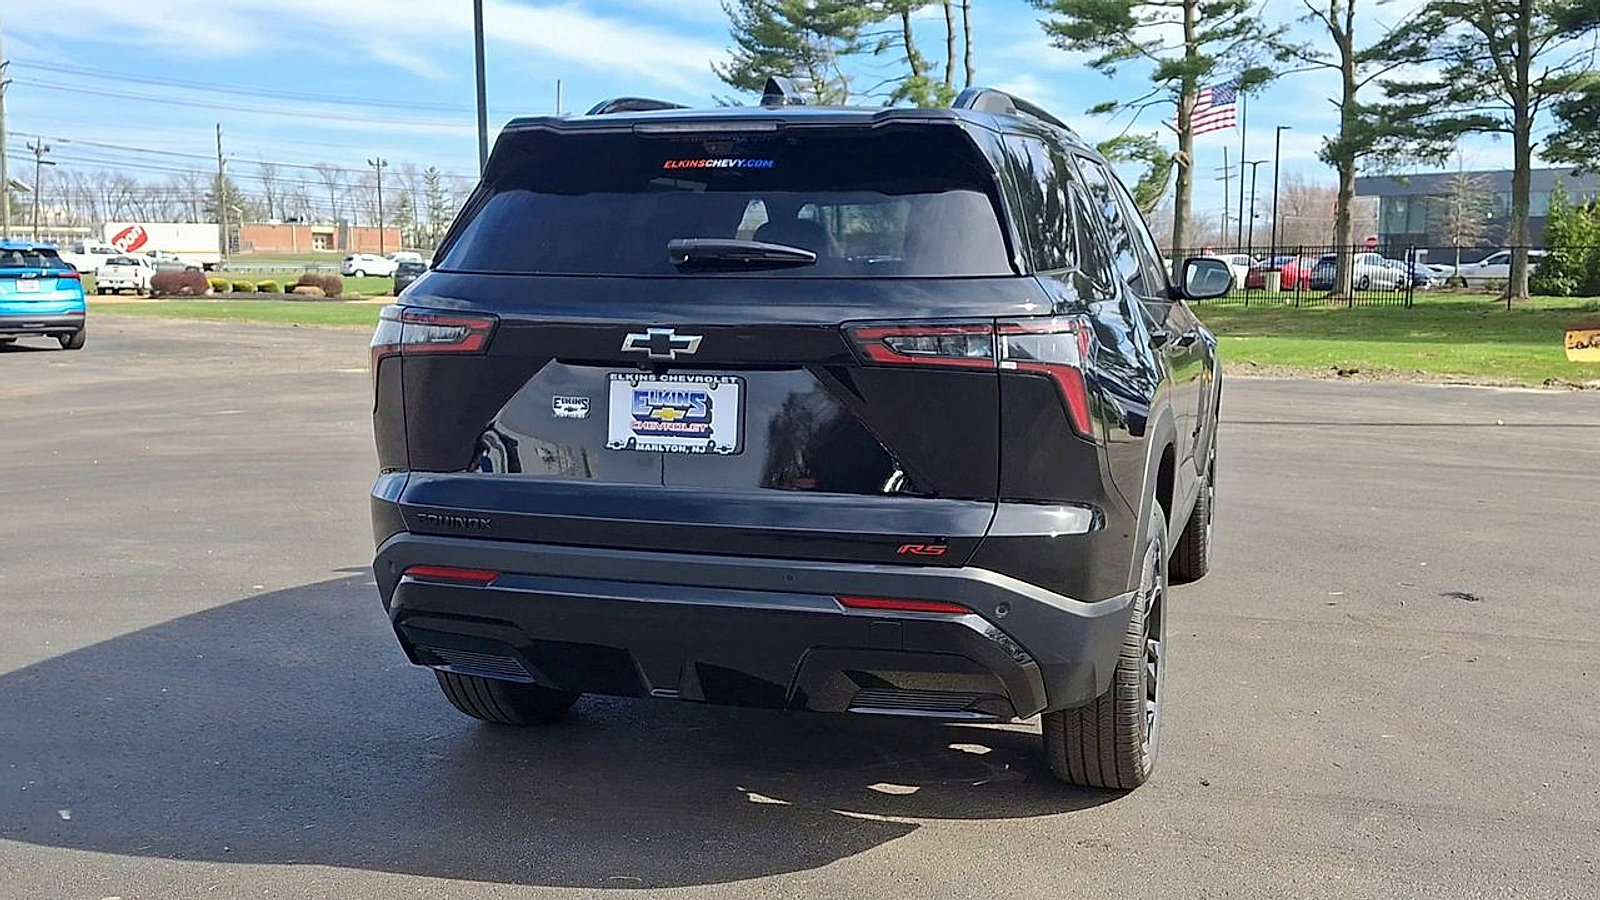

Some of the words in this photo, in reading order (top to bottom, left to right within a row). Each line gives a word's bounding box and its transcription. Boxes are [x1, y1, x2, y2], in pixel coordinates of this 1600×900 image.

[663, 159, 774, 169] ELKINSCHEVY.COM
[610, 373, 656, 382] ELKINS
[659, 374, 739, 384] CHEVROLET
[632, 388, 709, 418] ELKINS
[636, 443, 689, 453] MARLTON,
[691, 445, 706, 453] NJ
[896, 544, 948, 556] RS
